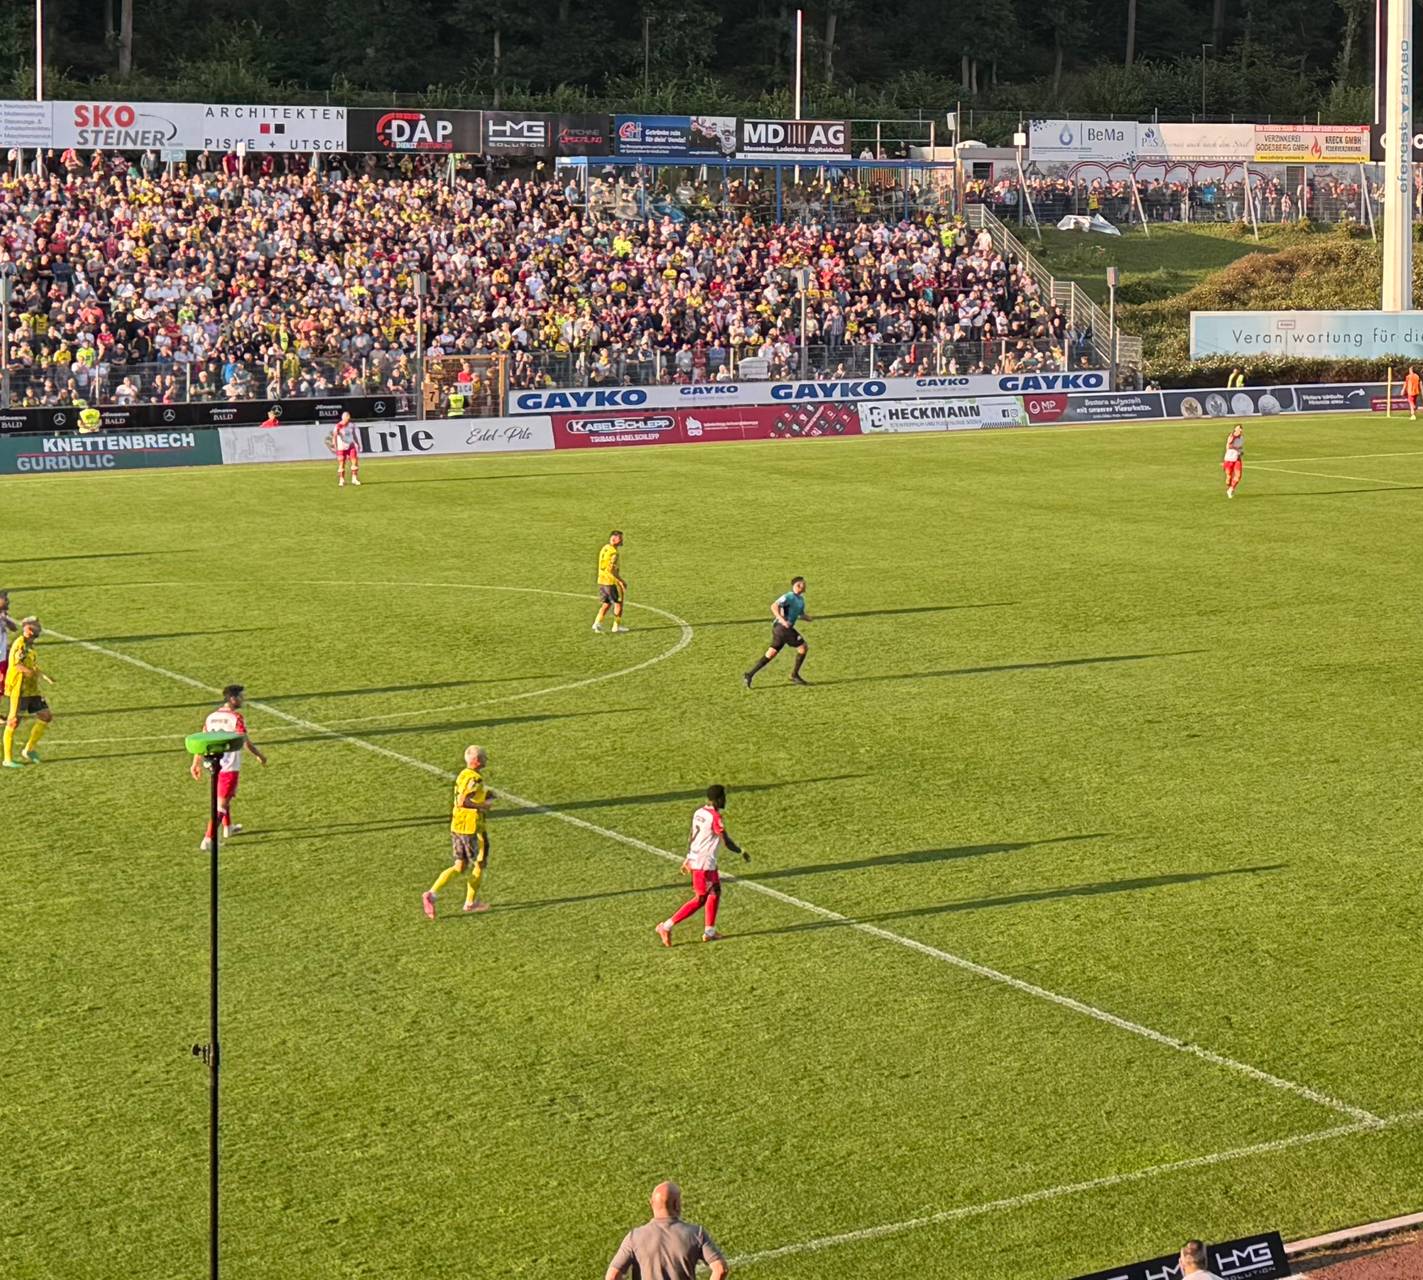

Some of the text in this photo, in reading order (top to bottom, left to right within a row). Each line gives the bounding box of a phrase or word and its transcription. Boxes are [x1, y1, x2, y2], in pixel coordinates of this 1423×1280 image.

[74, 104, 136, 129] SKO
[205, 106, 345, 120] ARCHITEKTEN
[390, 120, 454, 142] DAP
[488, 120, 545, 137] HMG
[743, 123, 845, 145] MD AG
[1087, 128, 1125, 141] BeMa
[76, 129, 167, 148] STEINER
[289, 140, 345, 151] UTSCH
[1264, 134, 1302, 143] VERZINKEREI
[1325, 135, 1343, 145] KRECK
[808, 145, 844, 154] Digitaldruck
[1255, 143, 1292, 152] GODESBERG
[1373, 327, 1397, 344] für
[429, 391, 435, 402] 7
[516, 373, 1104, 411] GAYKO GAYKO GAYKO GAYKO GAYKO
[1041, 399, 1057, 409] MP
[213, 413, 234, 421] BALD
[888, 405, 981, 421] HECKMANN
[1, 421, 23, 429] BALD
[104, 418, 126, 426] BALD
[42, 432, 196, 453] KNETTENBRECH
[359, 424, 435, 454] Irle
[16, 453, 116, 472] GURDULIC
[1215, 1242, 1272, 1272] HMG
